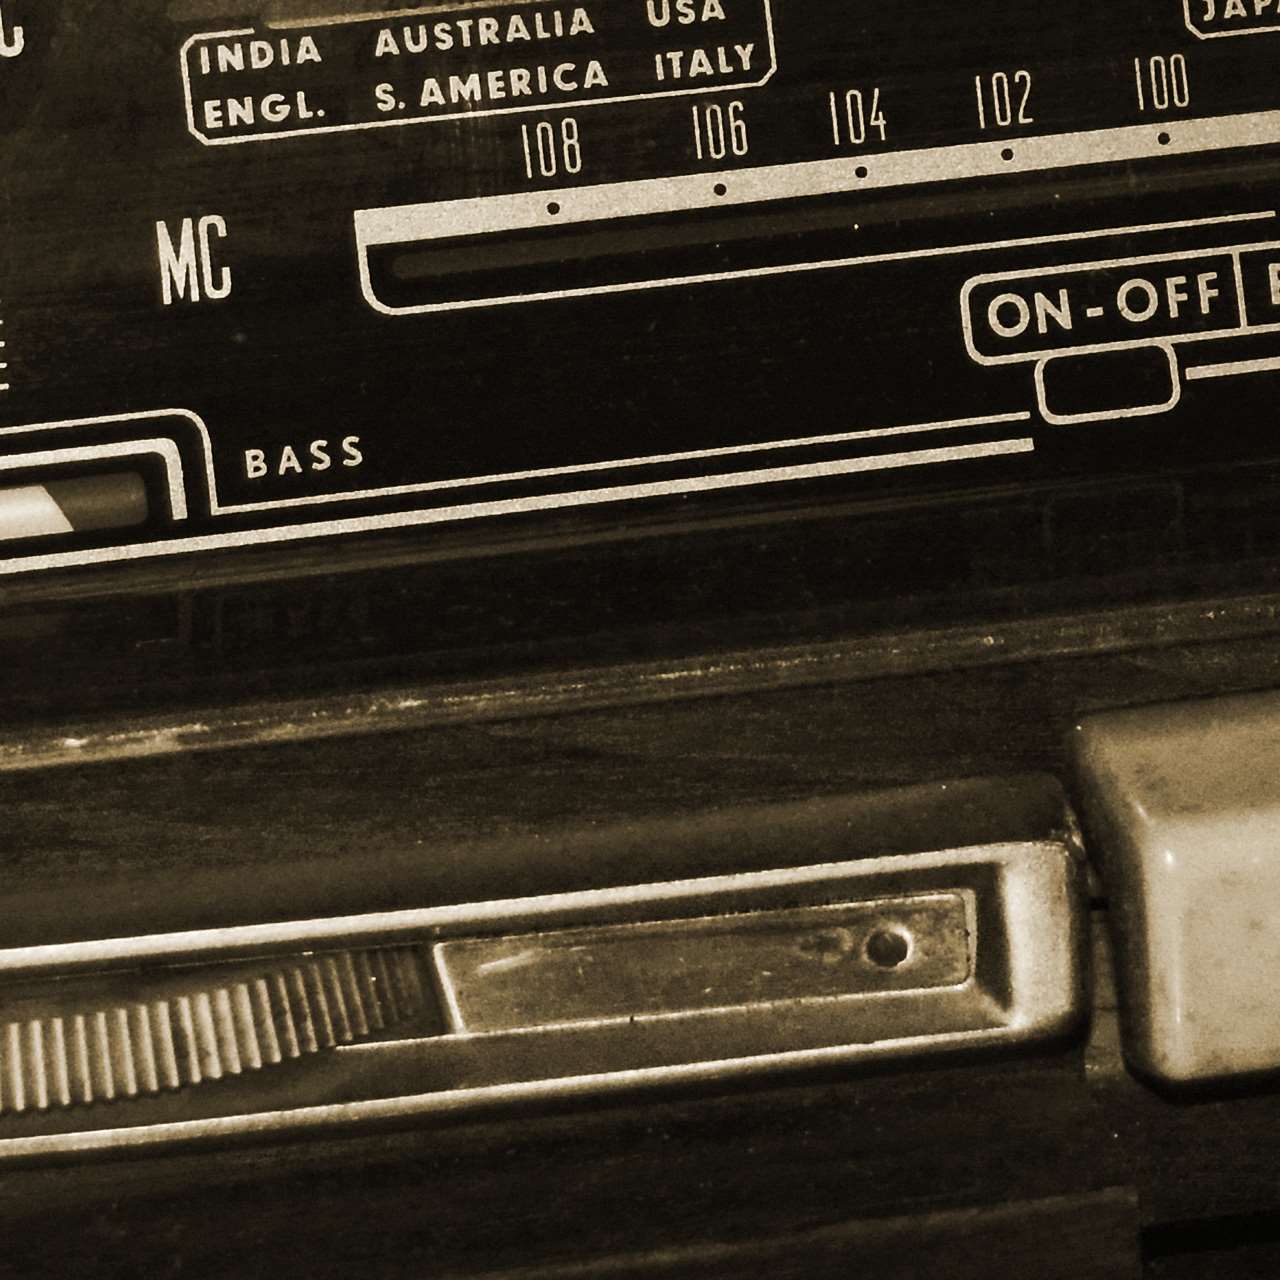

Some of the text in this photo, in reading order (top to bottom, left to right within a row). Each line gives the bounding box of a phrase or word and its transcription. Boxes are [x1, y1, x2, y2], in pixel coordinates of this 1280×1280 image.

[200, 36, 321, 74] INDIA
[375, 8, 594, 57] AUSTRALIA
[204, 44, 753, 128] ENGL. S. AMERICA ITALY
[975, 70, 1033, 129] 102
[1134, 54, 1189, 110] 100
[692, 101, 748, 159] 106
[830, 88, 886, 145] 104
[522, 118, 581, 178] 108
[156, 215, 231, 304] MC
[245, 436, 362, 478] BASS
